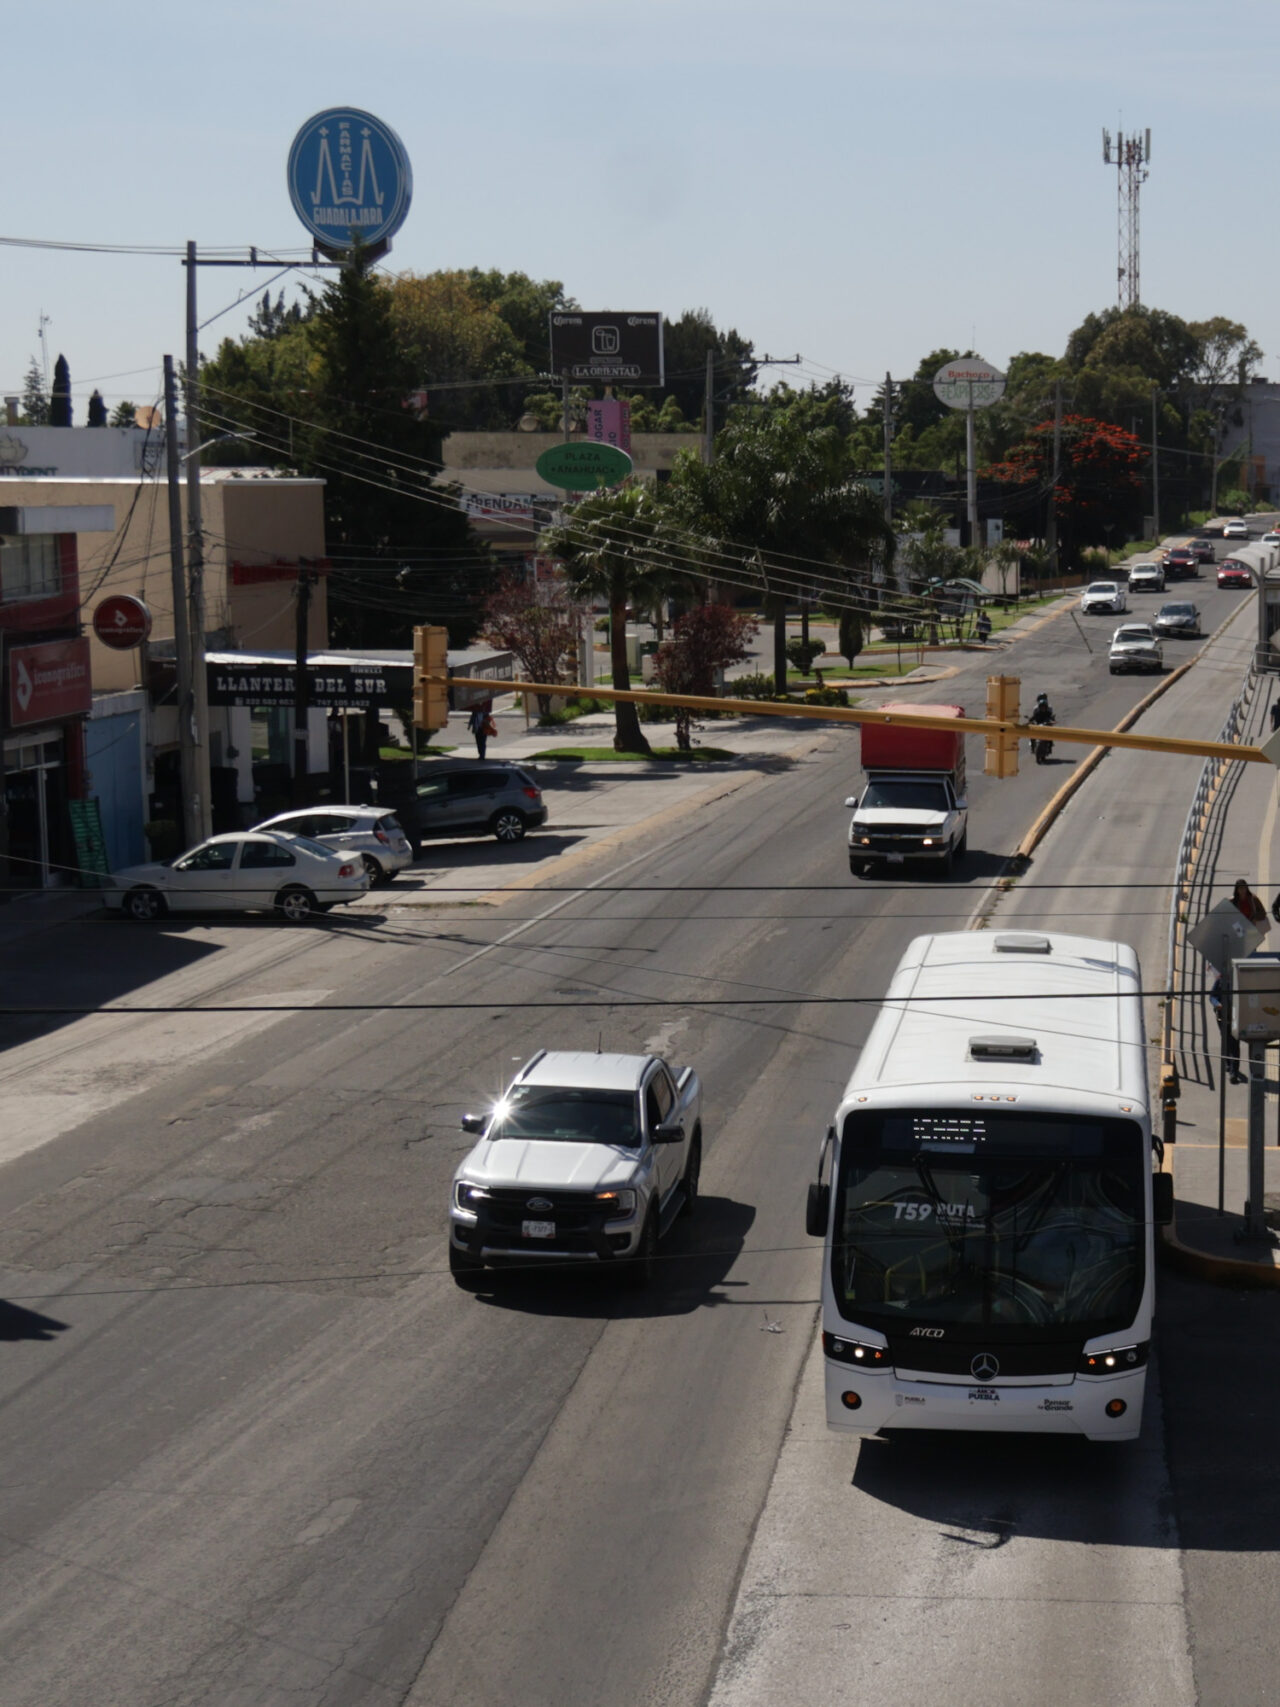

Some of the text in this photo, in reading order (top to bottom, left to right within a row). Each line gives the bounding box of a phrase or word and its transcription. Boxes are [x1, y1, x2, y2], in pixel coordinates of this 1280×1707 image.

[339, 122, 353, 195] FARMACIAS
[313, 207, 383, 226] GUADALAJARA
[553, 316, 583, 327] Corona
[627, 316, 657, 327] Corona
[575, 366, 637, 377] LA ORIENTAL
[948, 370, 990, 378] Bachoco
[946, 384, 991, 400] EXPRESS
[594, 409, 603, 442] OGAR
[566, 452, 601, 461] PLAZA
[557, 466, 609, 474] ANAHUAC
[217, 677, 387, 693] LLANTER DEL SUR
[893, 1202, 976, 1221] T59 RUTA
[1044, 1404, 1074, 1412] Grande
